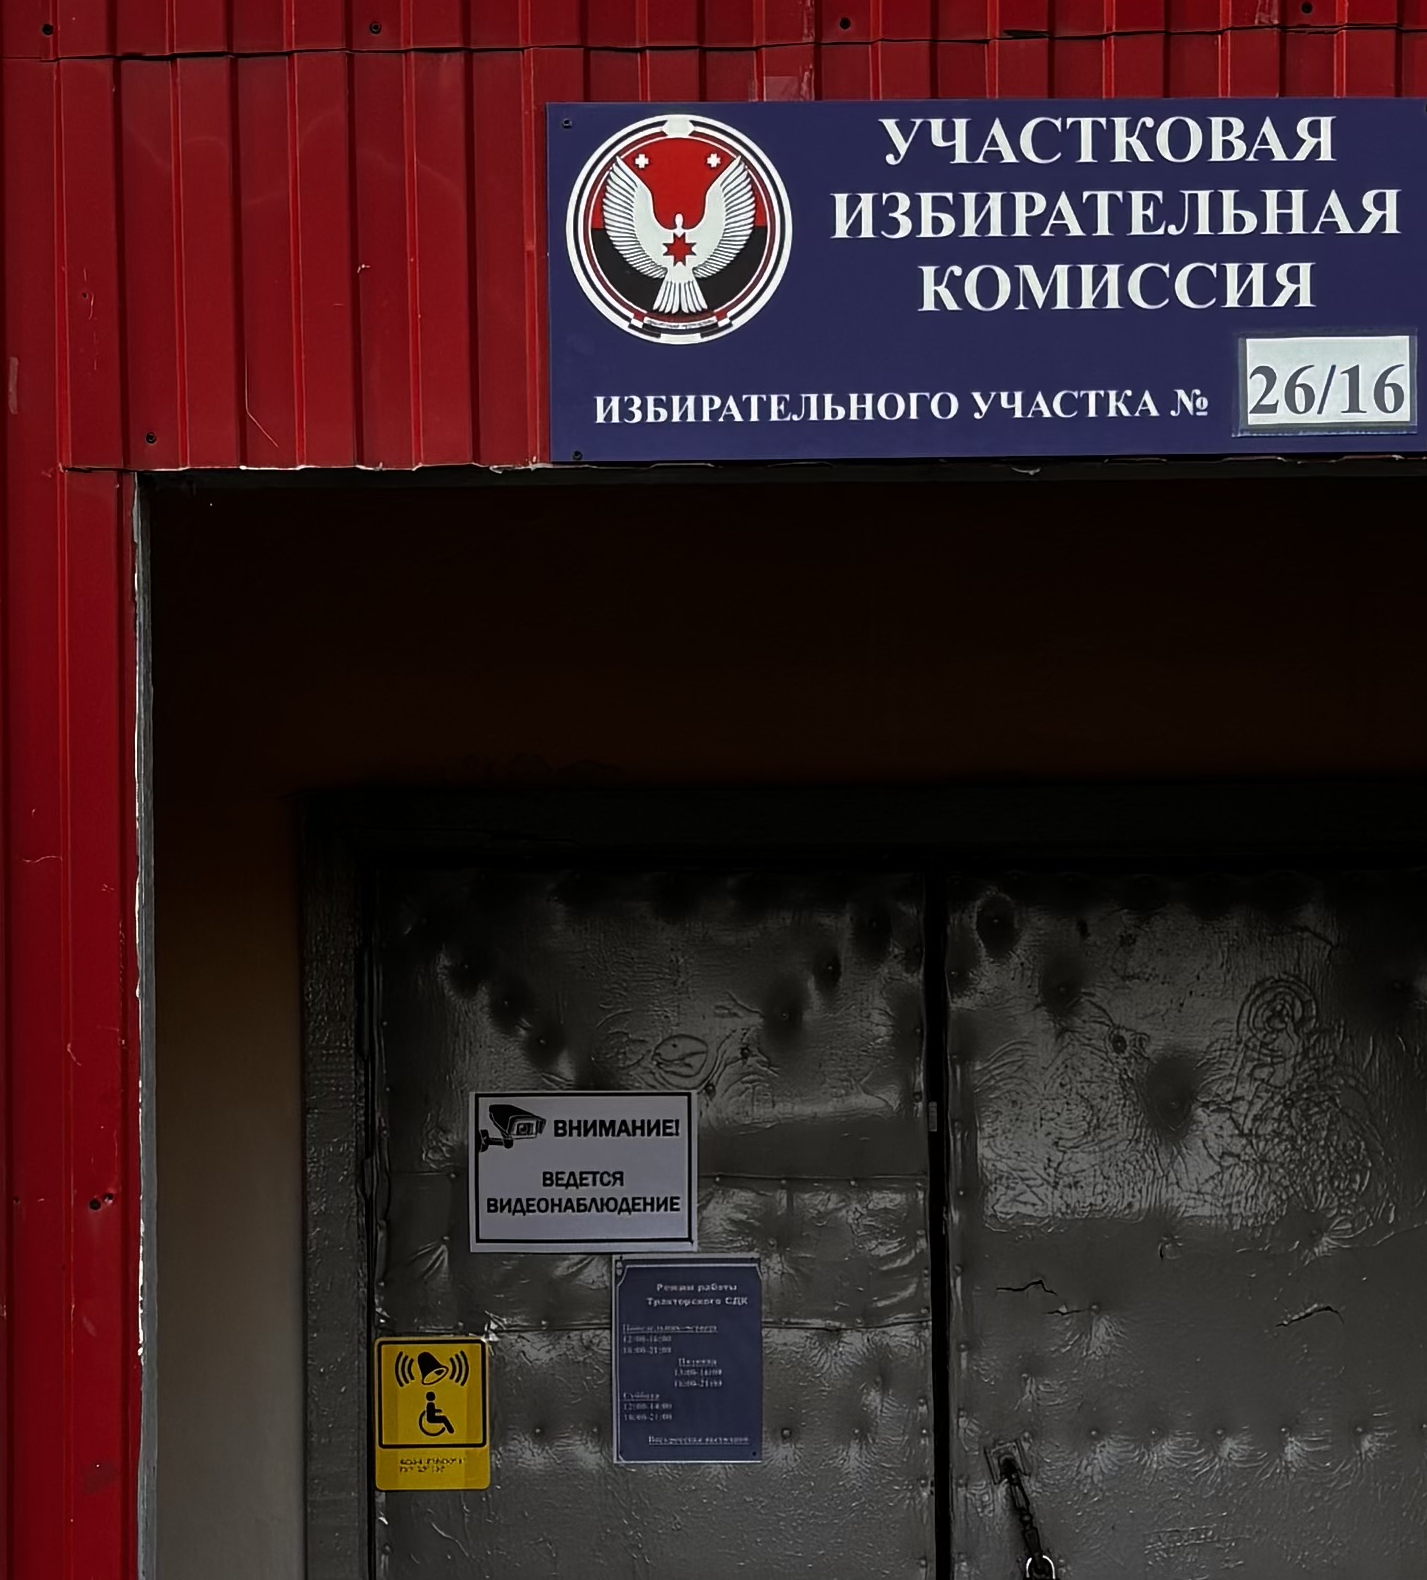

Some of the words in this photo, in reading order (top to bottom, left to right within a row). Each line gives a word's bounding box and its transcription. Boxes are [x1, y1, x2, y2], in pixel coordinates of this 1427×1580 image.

[879, 117, 1335, 165] УЧАСТКОВАЯ
[831, 190, 1400, 238] ИЗБИРАТЕЛЬНАЯ
[919, 263, 1315, 311] КОМИССИЯ
[596, 392, 958, 423] ИЗБИРАТЕЛЬНОГО
[972, 390, 1159, 419] УЧАСТКА
[1171, 389, 1208, 416] №
[1248, 361, 1407, 418] 26/16
[554, 1119, 679, 1137] ВНИМАНИЕ!
[543, 1171, 623, 1189] ВЕДЕТСЯ
[487, 1196, 680, 1216] ВИДЕОНАБЛЮДЕНИЕ
